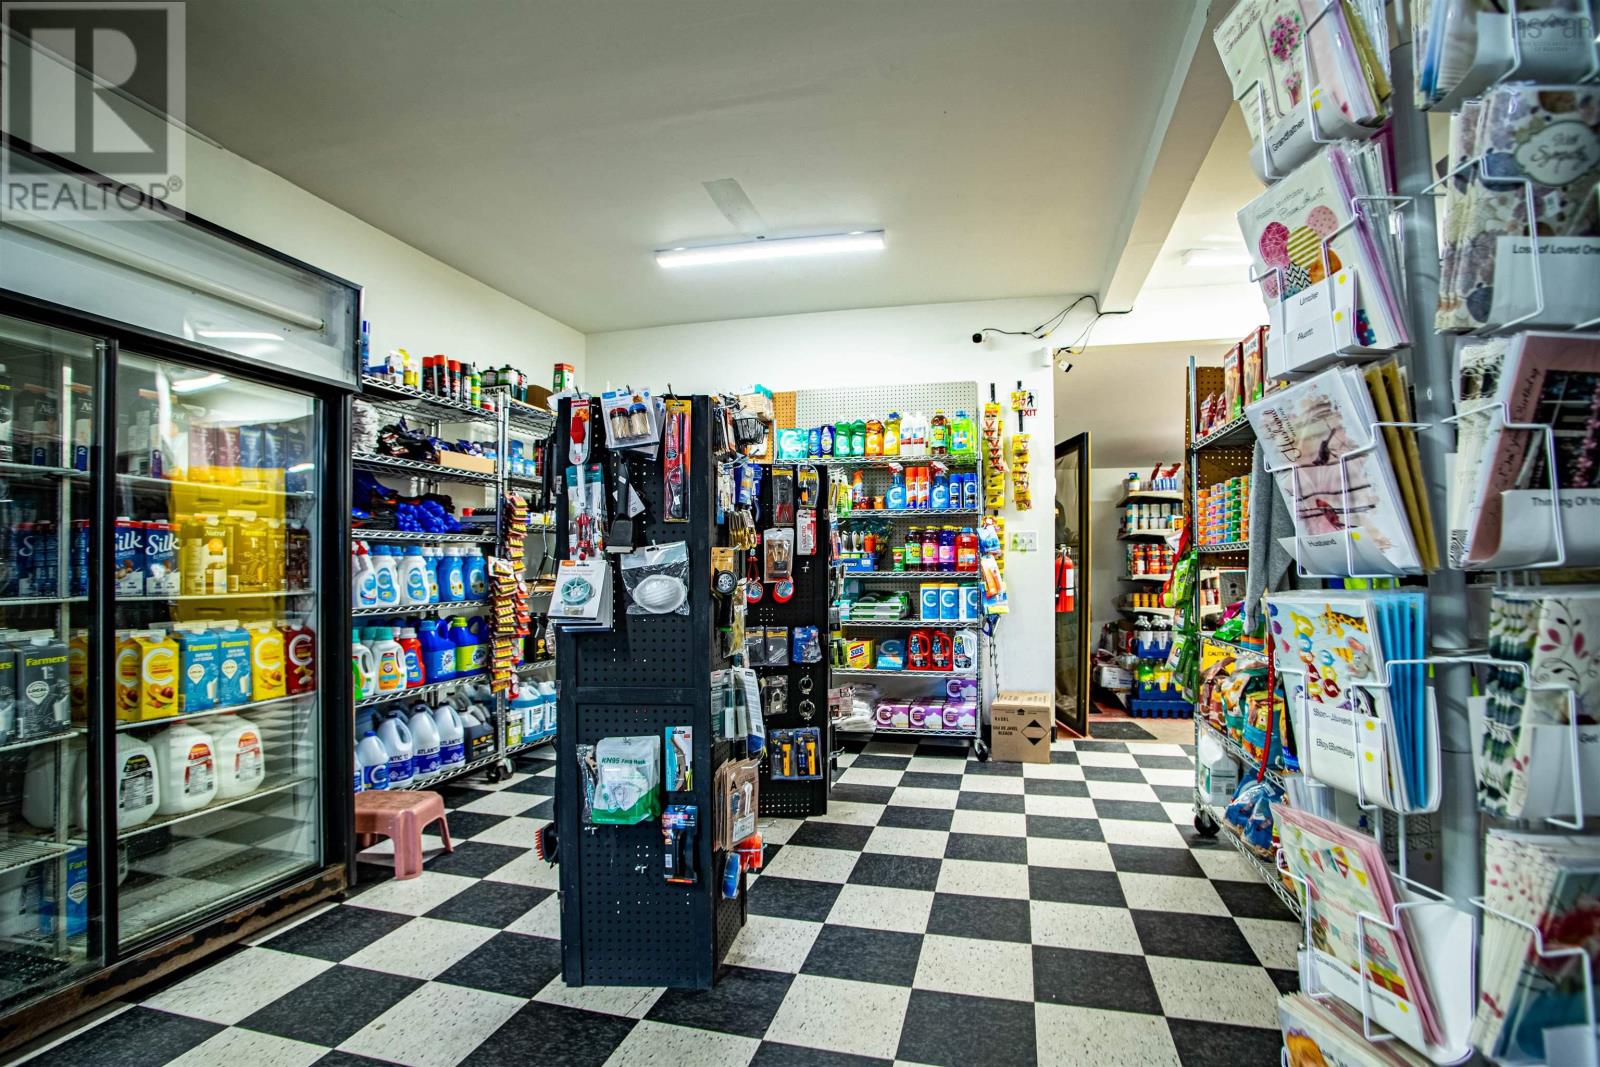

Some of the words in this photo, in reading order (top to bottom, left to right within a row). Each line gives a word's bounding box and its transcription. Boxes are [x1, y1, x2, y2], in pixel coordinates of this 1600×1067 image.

[1271, 119, 1305, 152] Grandfather
[1551, 244, 1580, 254] Loved
[1307, 537, 1337, 548] Husband
[26, 655, 67, 667] Farmers
